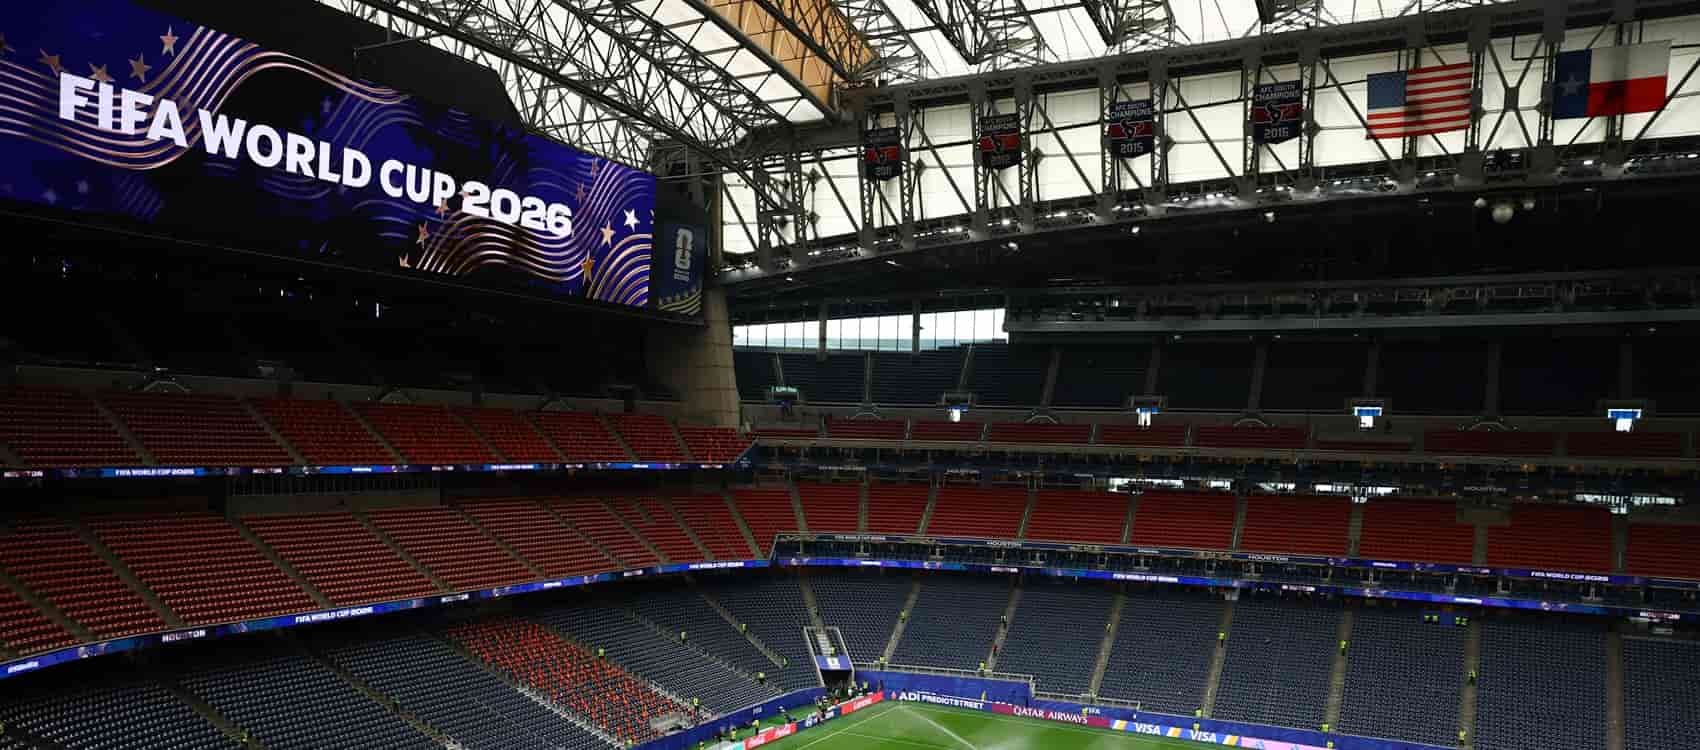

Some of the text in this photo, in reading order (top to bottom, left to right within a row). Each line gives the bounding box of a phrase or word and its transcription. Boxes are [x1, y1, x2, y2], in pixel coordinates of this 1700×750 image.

[1264, 127, 1289, 140] 2016
[59, 71, 573, 238] FIFA WORLD CUP 2026
[1120, 142, 1144, 154] 2015
[115, 468, 131, 476] FIFA
[1248, 553, 1289, 562] HOUSTON
[1531, 571, 1548, 579] FIFA
[1549, 572, 1570, 580] WORLD
[1571, 573, 1585, 581] CUP
[295, 615, 311, 625] FIFA
[336, 608, 349, 618] CUP
[162, 629, 206, 643] HOUSTON
[1013, 705, 1088, 725] QATAR AIRWAYS
[1135, 722, 1161, 736] VISA
[1190, 729, 1217, 743] VISA
